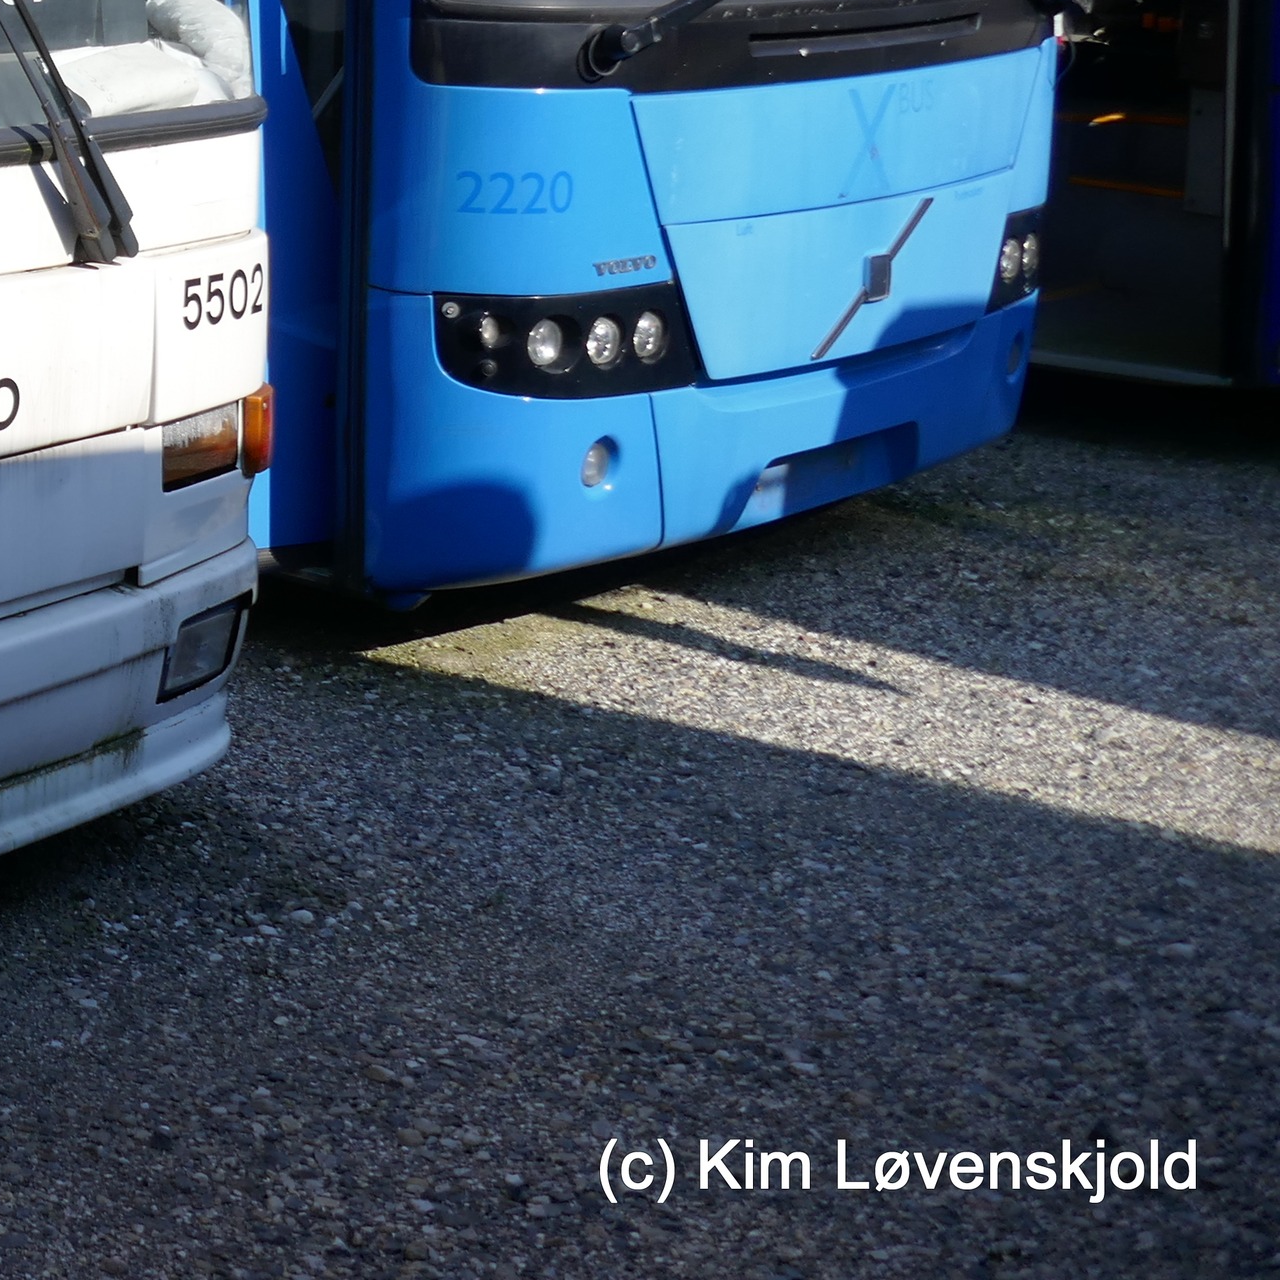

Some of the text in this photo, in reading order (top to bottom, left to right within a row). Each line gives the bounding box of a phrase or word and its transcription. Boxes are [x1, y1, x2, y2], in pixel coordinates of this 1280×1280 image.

[899, 80, 934, 113] BUS
[456, 170, 574, 214] 2220
[592, 254, 656, 277] VOLVO
[183, 262, 265, 330] 5502
